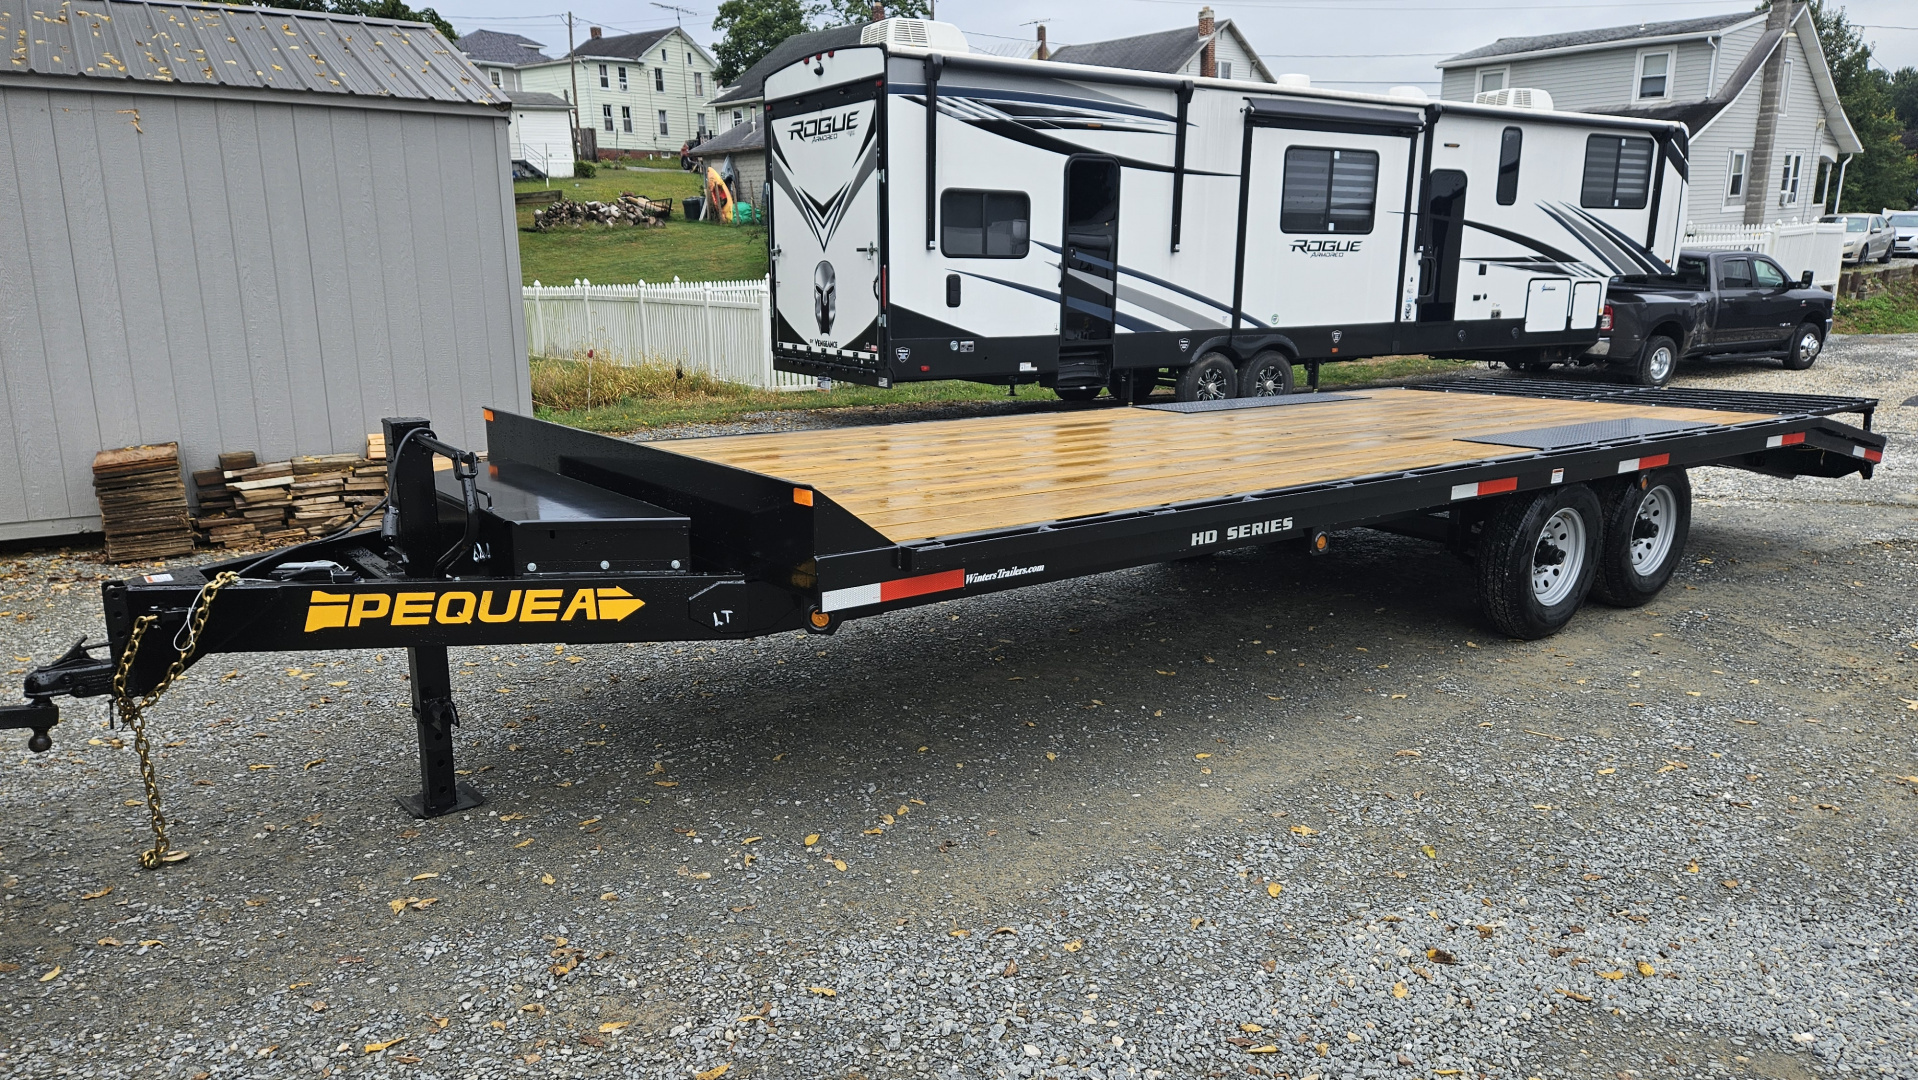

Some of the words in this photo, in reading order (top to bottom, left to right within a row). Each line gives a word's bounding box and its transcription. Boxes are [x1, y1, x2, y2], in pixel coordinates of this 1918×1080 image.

[787, 110, 860, 142] ROGUE
[811, 133, 838, 144] ARMORED
[1289, 239, 1363, 254] ROGUE
[1190, 529, 1218, 547] HD
[1227, 516, 1293, 541] SERIES
[965, 564, 1045, 585] WintersTrailers.com
[347, 588, 598, 627] PEQUEA
[712, 609, 734, 627] LT
